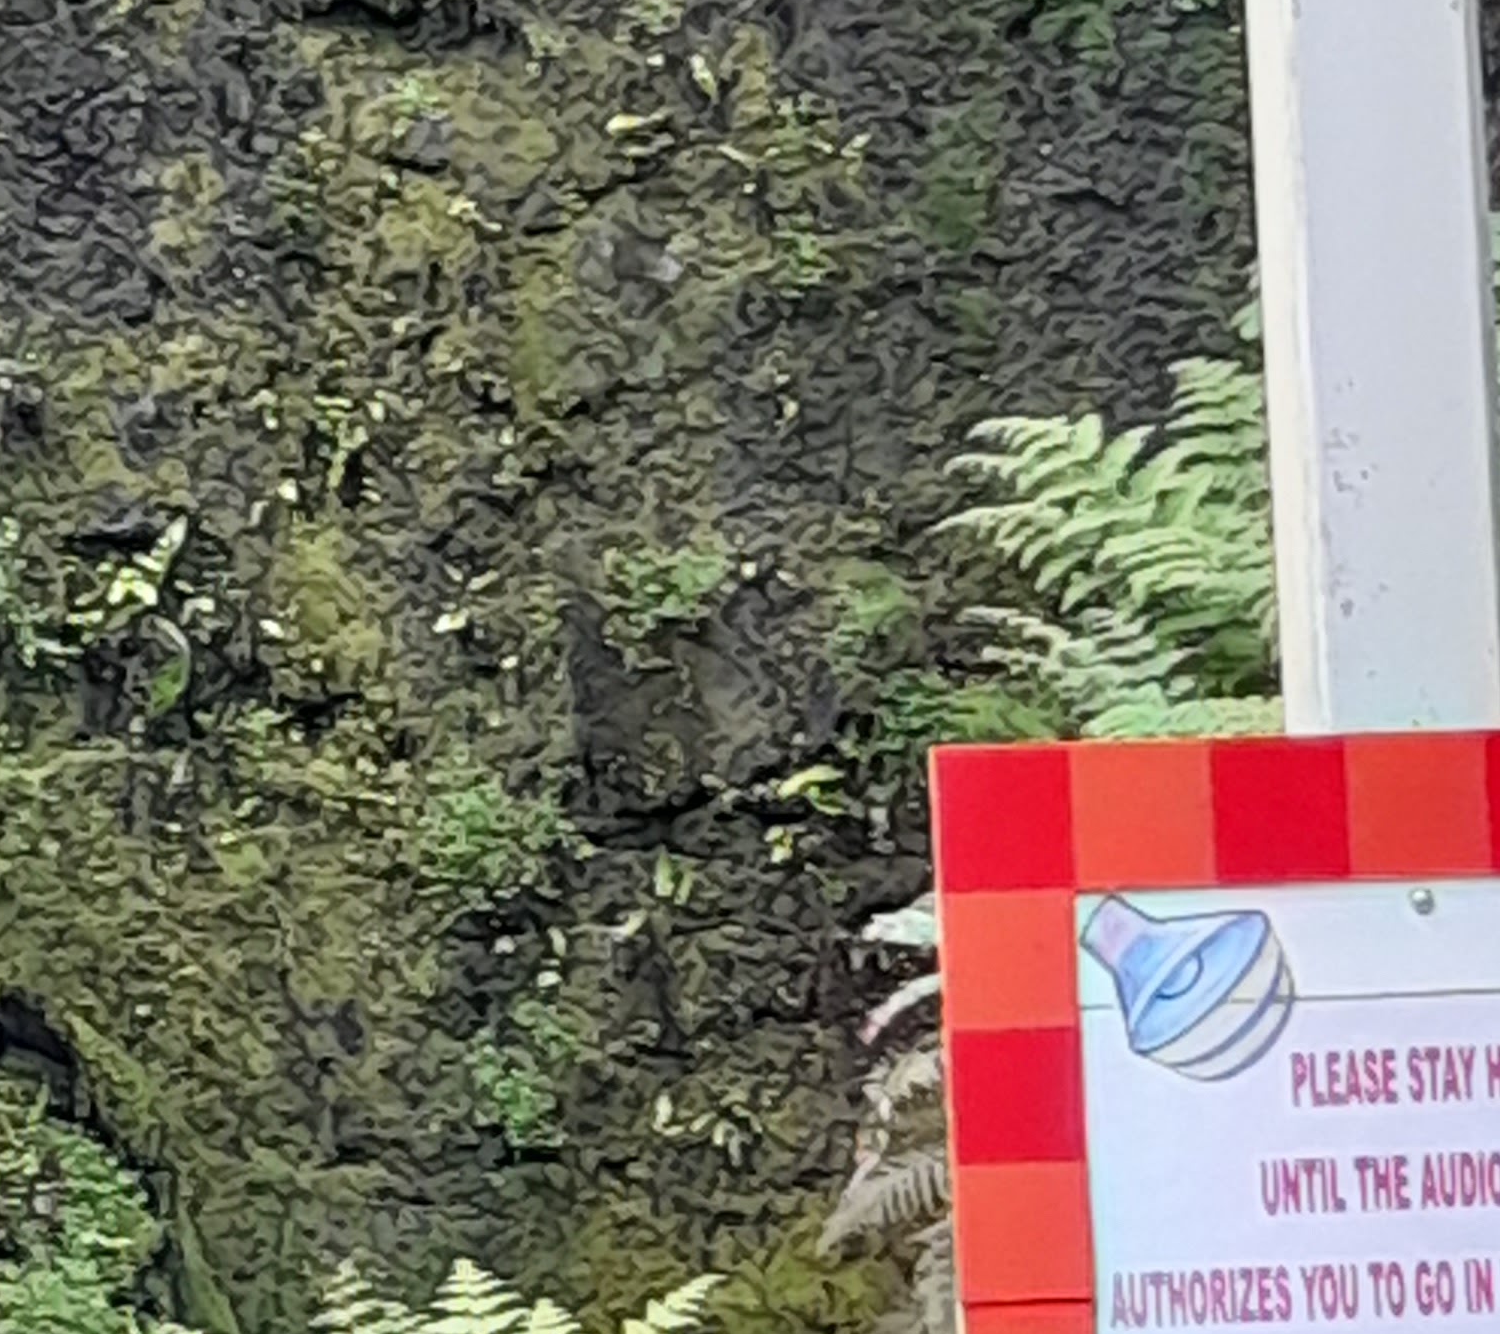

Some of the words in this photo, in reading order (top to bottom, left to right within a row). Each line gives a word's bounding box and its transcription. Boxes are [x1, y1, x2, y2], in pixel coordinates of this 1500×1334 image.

[1291, 1049, 1398, 1107] PLEASE
[1407, 1046, 1476, 1103] STAY
[1260, 1157, 1347, 1216] UNTIL
[1354, 1155, 1411, 1213] THE
[1110, 1265, 1292, 1328] AUTHORIZES
[1299, 1264, 1358, 1321] YOU
[1367, 1261, 1405, 1317] TO
[1415, 1260, 1455, 1316] GO
[1464, 1258, 1494, 1313] IN
